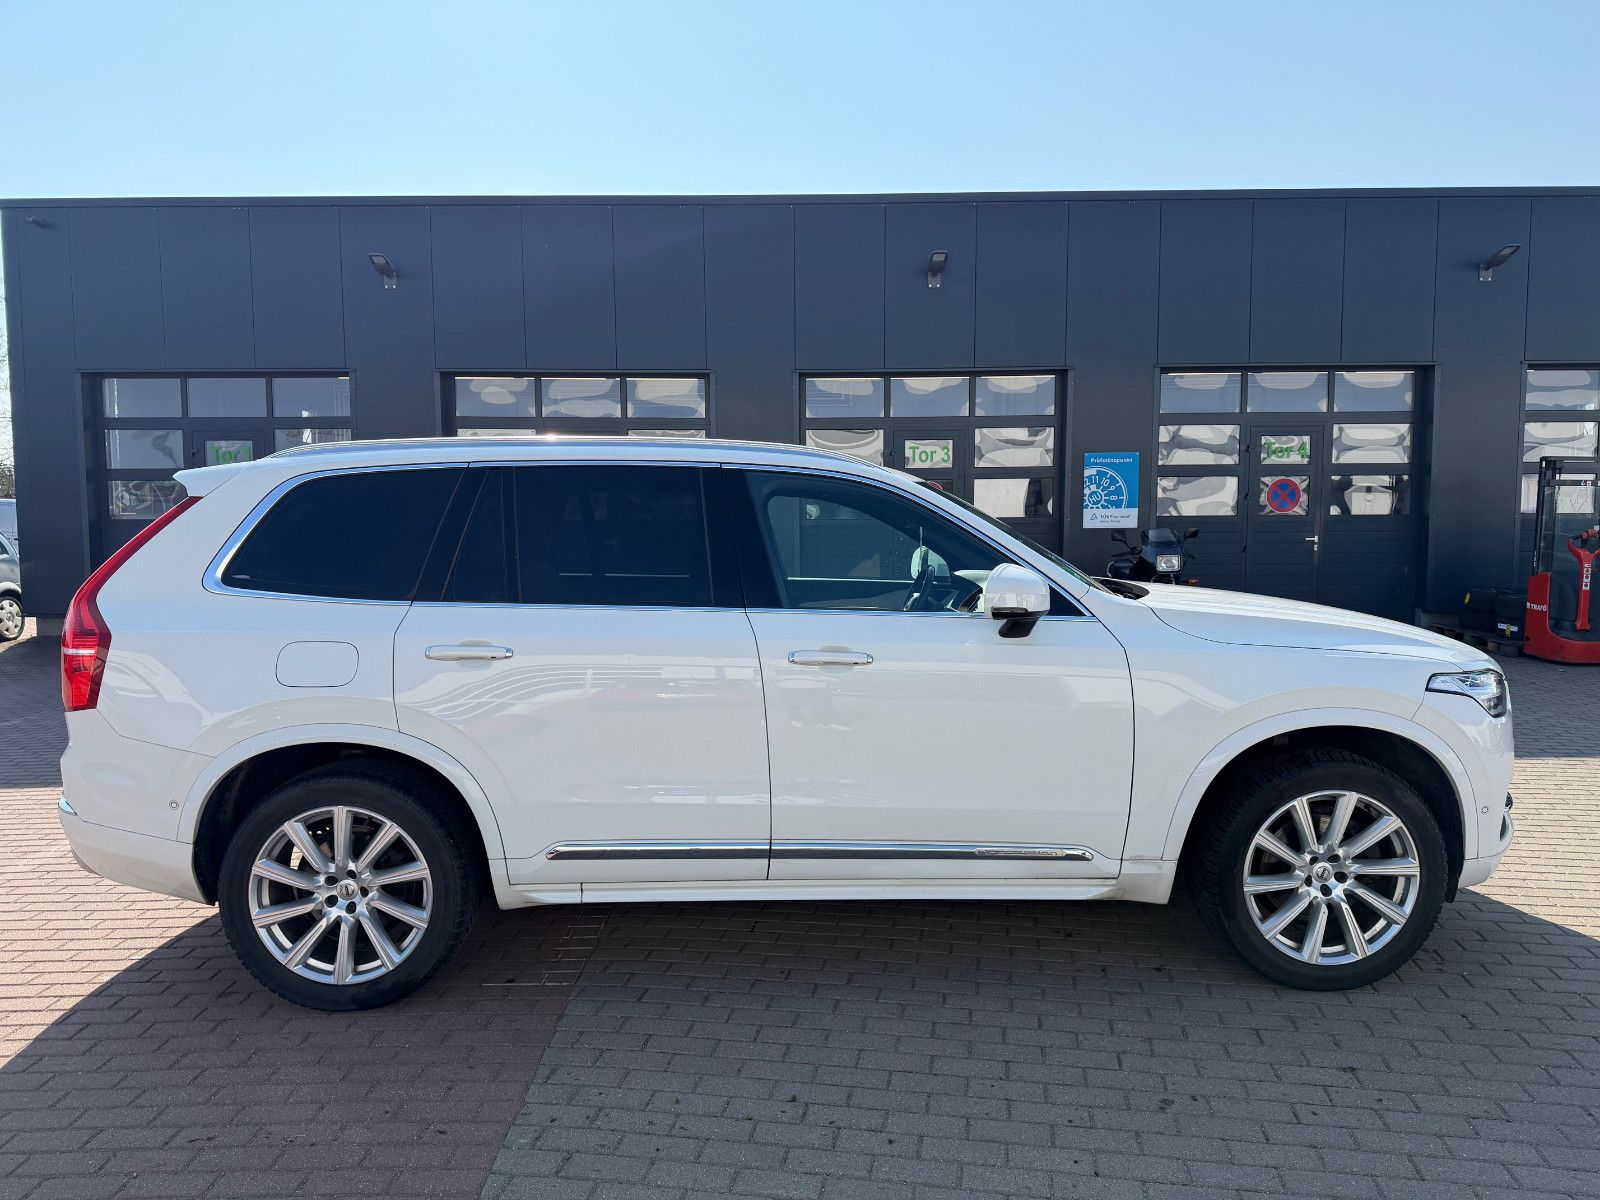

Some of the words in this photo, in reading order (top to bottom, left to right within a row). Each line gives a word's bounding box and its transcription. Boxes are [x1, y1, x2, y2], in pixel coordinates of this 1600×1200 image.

[908, 446, 937, 463] Tor
[942, 446, 951, 463] 3
[1263, 441, 1295, 459] Tor
[1297, 441, 1308, 459] 4
[1092, 475, 1098, 483] 11
[1101, 477, 1110, 487] 10
[1089, 492, 1101, 504] HU
